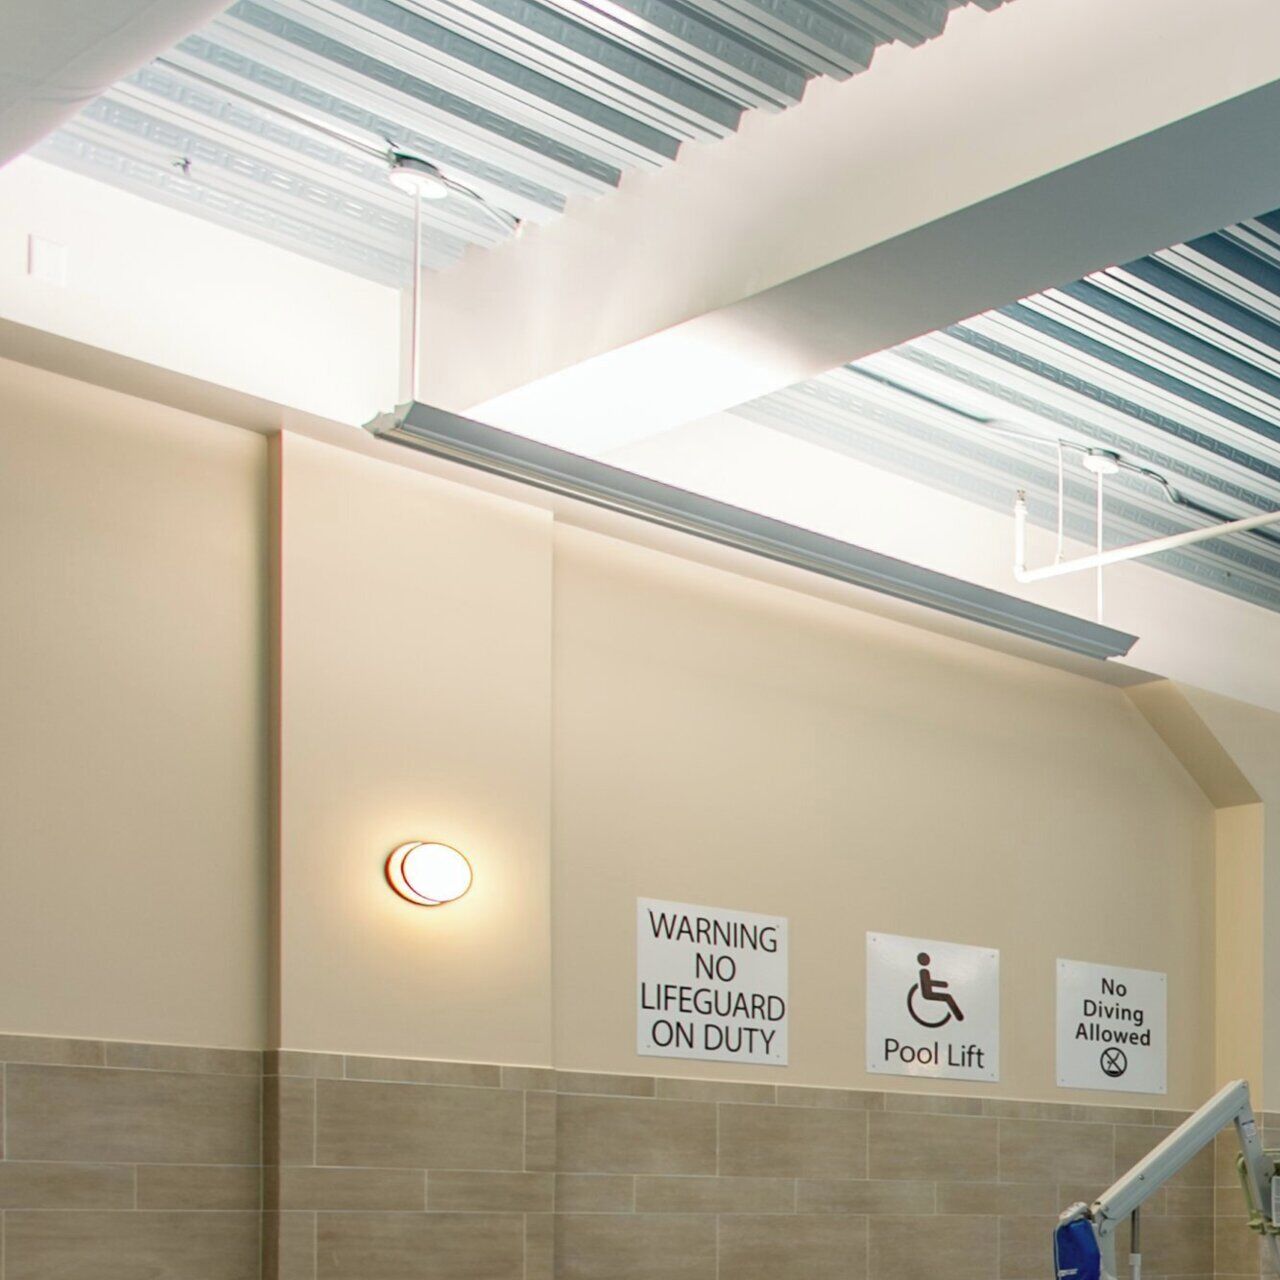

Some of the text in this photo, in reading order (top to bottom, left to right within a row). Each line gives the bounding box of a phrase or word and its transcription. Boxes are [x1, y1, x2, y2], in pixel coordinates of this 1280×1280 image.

[649, 910, 777, 953] WARNING
[696, 952, 736, 982] NO
[641, 982, 785, 1021] LIFEGUARD
[1101, 977, 1127, 997] No
[1083, 999, 1144, 1027] Diving
[652, 1019, 776, 1055] ON DUTY
[1075, 1022, 1151, 1047] Allowed
[884, 1037, 985, 1069] Pool Lift
